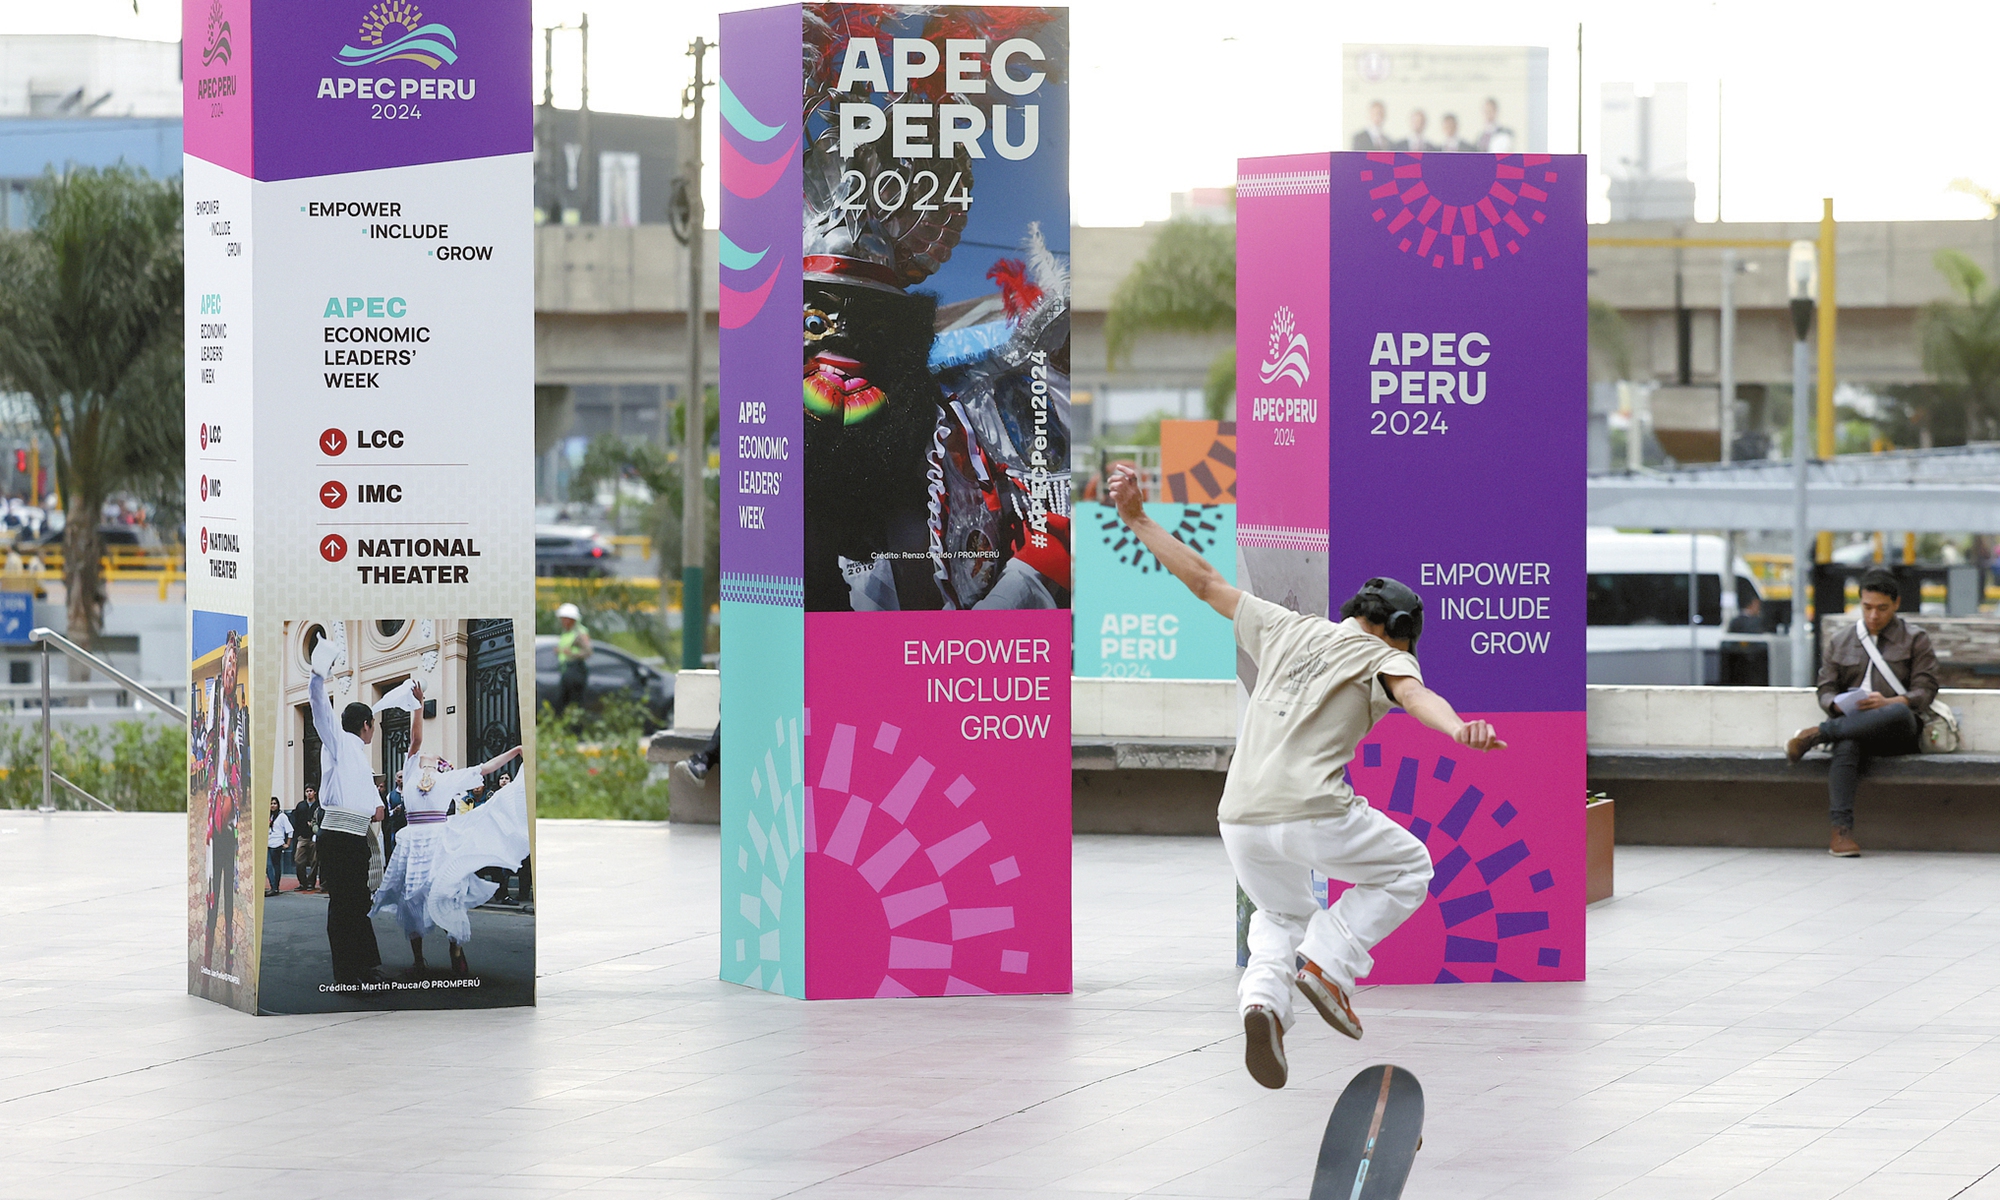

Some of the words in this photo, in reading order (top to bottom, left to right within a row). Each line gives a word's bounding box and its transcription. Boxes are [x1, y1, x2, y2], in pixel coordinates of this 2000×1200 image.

[837, 37, 1047, 96] APEC
[198, 78, 217, 100] APEC
[218, 75, 237, 97] PERU
[317, 77, 396, 99] APEC
[400, 78, 476, 100] PERU
[211, 103, 224, 118] 2024
[371, 104, 422, 120] 2024
[839, 102, 1040, 161] PERU
[839, 170, 974, 212] 2024
[309, 202, 402, 218] EMPOWER
[369, 224, 449, 240] INCLUDE
[436, 246, 494, 262] GROW
[200, 293, 222, 315] APEC
[323, 297, 407, 319] APEC
[324, 326, 431, 344] ECONOMIC
[324, 350, 417, 366] LEADERS'
[1369, 332, 1491, 367] APEC
[200, 368, 216, 384] WEEK
[324, 373, 380, 389] WEEK
[1370, 371, 1487, 405] PERU
[738, 401, 767, 424] APEC
[1252, 397, 1284, 422] APEC
[1285, 398, 1317, 424] PERU
[1370, 411, 1449, 435] 2024
[209, 425, 222, 444] LCC
[357, 430, 404, 449] LCC
[1273, 428, 1296, 446] 2024
[739, 435, 789, 461] ECONOMIC
[1031, 349, 1048, 548] #APECPeru2024
[209, 479, 221, 498] IMC
[357, 485, 403, 503] IMC
[739, 470, 783, 496] LEADERS'
[738, 505, 766, 530] WEEK
[209, 532, 240, 553] NATIONAL
[357, 538, 481, 557] NATIONAL
[870, 550, 901, 560] Crédito:
[926, 551, 953, 559] Galdo
[957, 549, 1000, 559] PROMPERÚ
[209, 559, 237, 580] THEATER
[357, 566, 469, 584] THEATER
[848, 563, 874, 575] 2010
[1420, 563, 1551, 586] EMPOWER
[1441, 597, 1551, 620] INCLUDE
[1100, 613, 1180, 636] APEC
[903, 638, 1051, 666] EMPOWER
[1101, 638, 1177, 660] PERU
[1470, 631, 1551, 654] GROW
[1101, 662, 1151, 678] 2024
[927, 676, 1051, 703] INCLUDE
[960, 713, 1052, 741] GROW
[318, 982, 360, 993] Créditos:
[361, 980, 390, 991] Martín
[431, 976, 481, 989] PROMPERÚ
